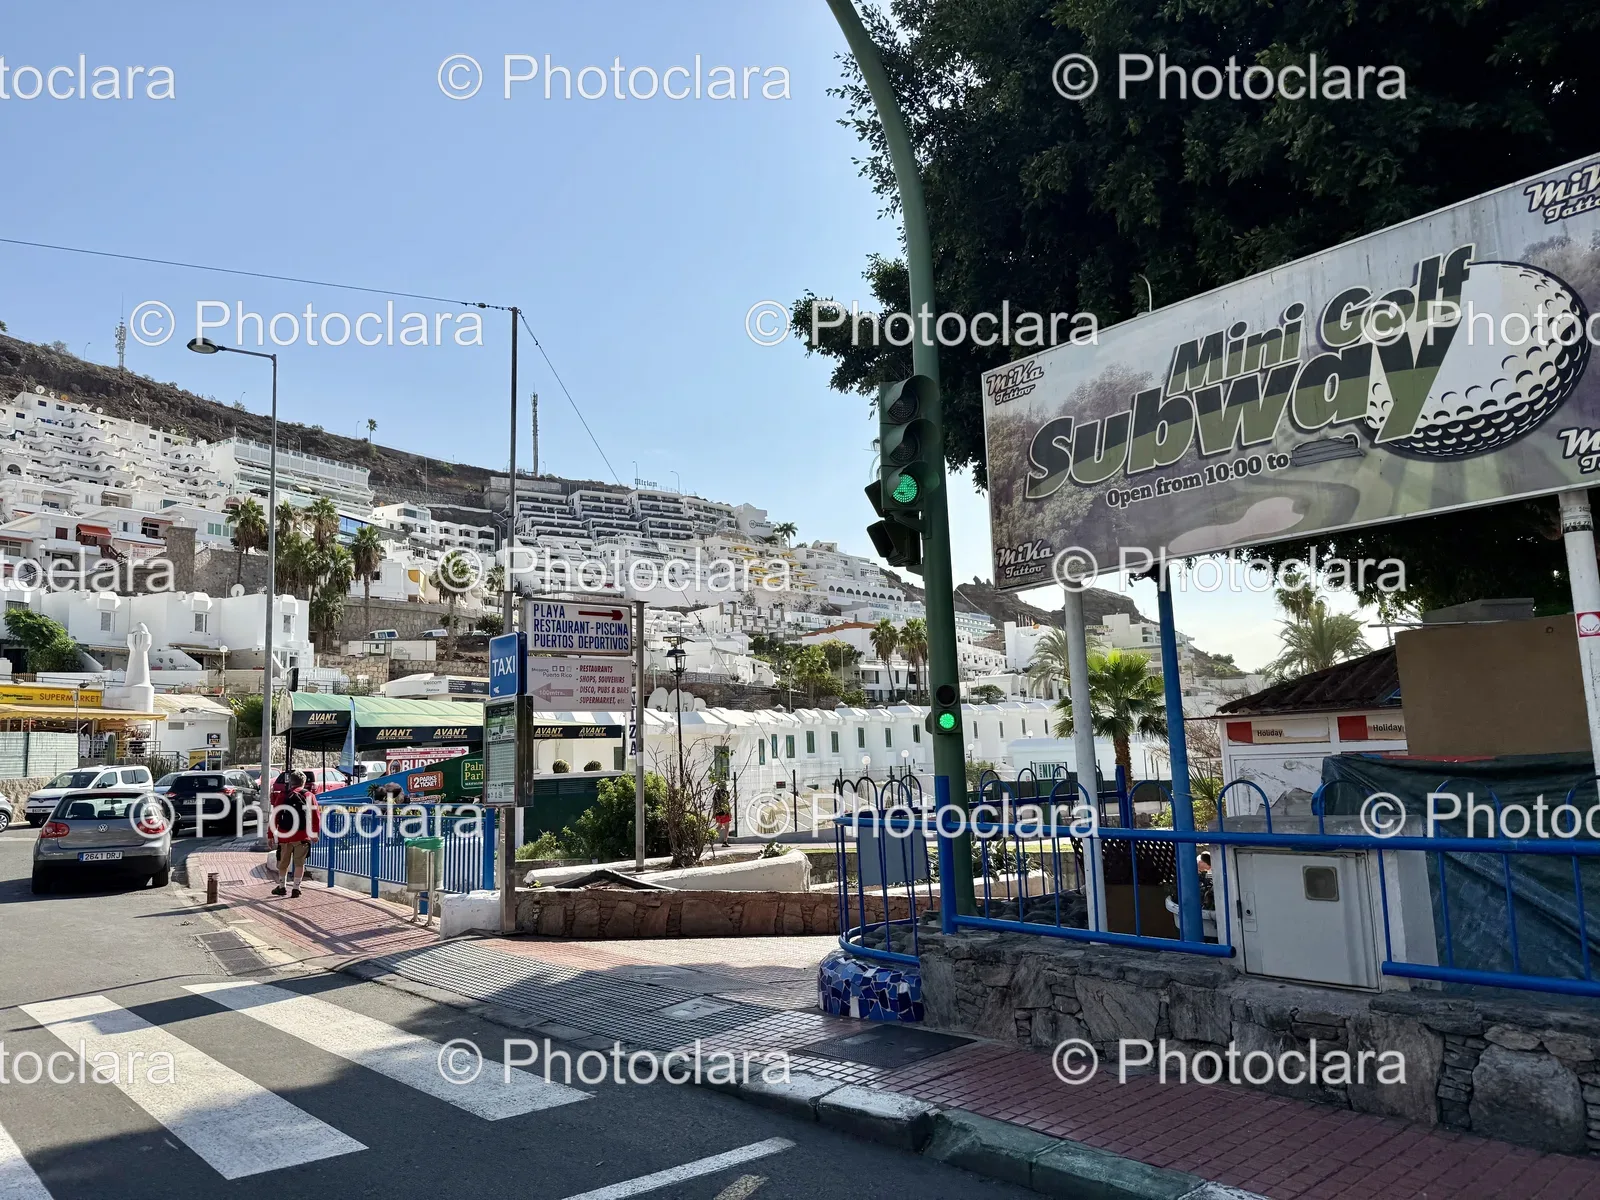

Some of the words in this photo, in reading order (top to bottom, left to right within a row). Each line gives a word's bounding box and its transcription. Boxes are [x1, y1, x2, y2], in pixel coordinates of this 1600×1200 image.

[1166, 302, 1306, 398] Mini
[1319, 243, 1476, 348] Golf
[995, 384, 1036, 405] Tattoo
[1106, 487, 1152, 509] Open
[1156, 472, 1202, 497] from
[1206, 456, 1262, 484] 10:00
[1267, 453, 1291, 471] to
[1005, 564, 1047, 579] Tattoo
[533, 604, 566, 618] PLAYA
[534, 634, 574, 648] PUERTOS
[578, 636, 629, 650] DEPORTIVOS
[492, 655, 516, 677] TAXI
[579, 665, 613, 673] RESTAURANTS
[309, 713, 338, 721] AVANT
[433, 728, 467, 736] AVANT
[1256, 729, 1283, 738] Holiday
[1372, 724, 1402, 733] Holiday
[413, 777, 420, 788] 2
[84, 852, 104, 861] 2641
[106, 851, 122, 860] DRJ
